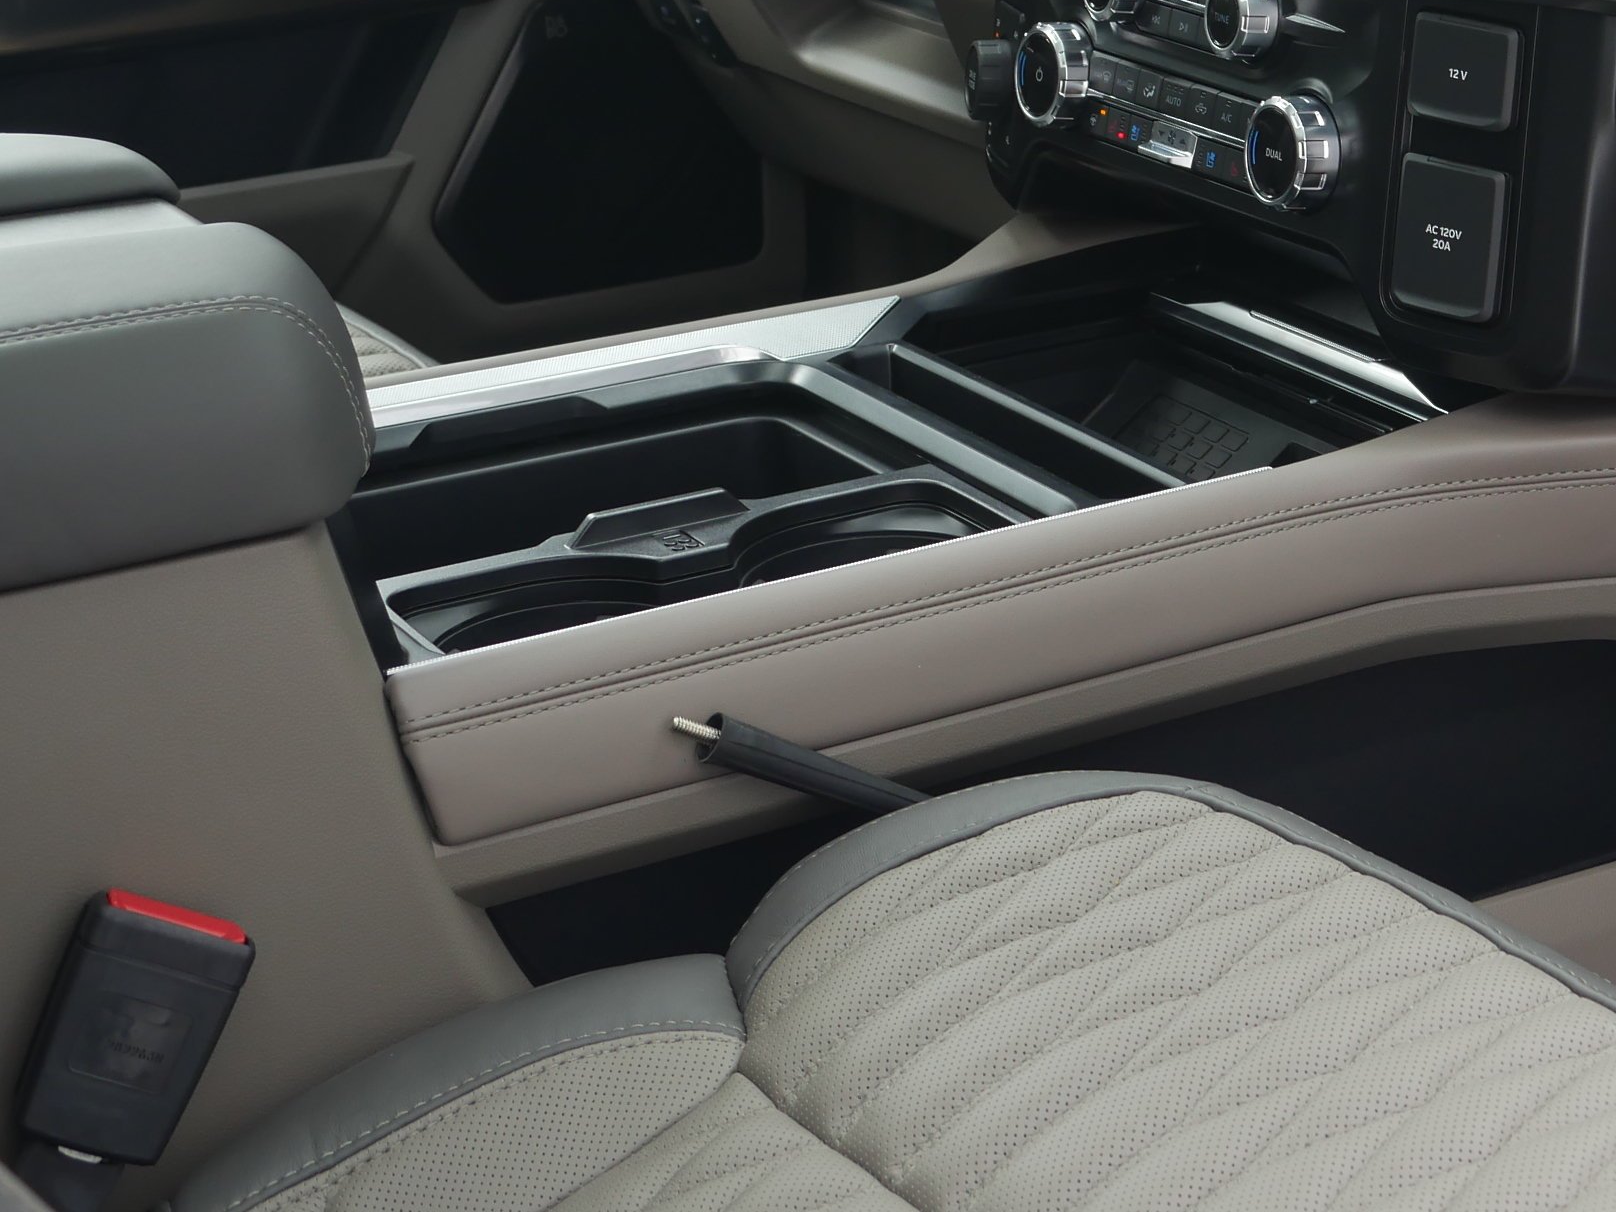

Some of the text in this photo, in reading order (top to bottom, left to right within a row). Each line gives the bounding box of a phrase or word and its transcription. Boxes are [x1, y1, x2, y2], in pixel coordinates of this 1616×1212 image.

[1214, 11, 1231, 26] TUNE
[1448, 67, 1468, 82] 12 V
[1165, 94, 1182, 108] AUTO
[1220, 113, 1232, 124] A/C
[1264, 147, 1283, 163] DUAL
[1425, 223, 1462, 240] AC 120V
[1431, 238, 1452, 252] 20A
